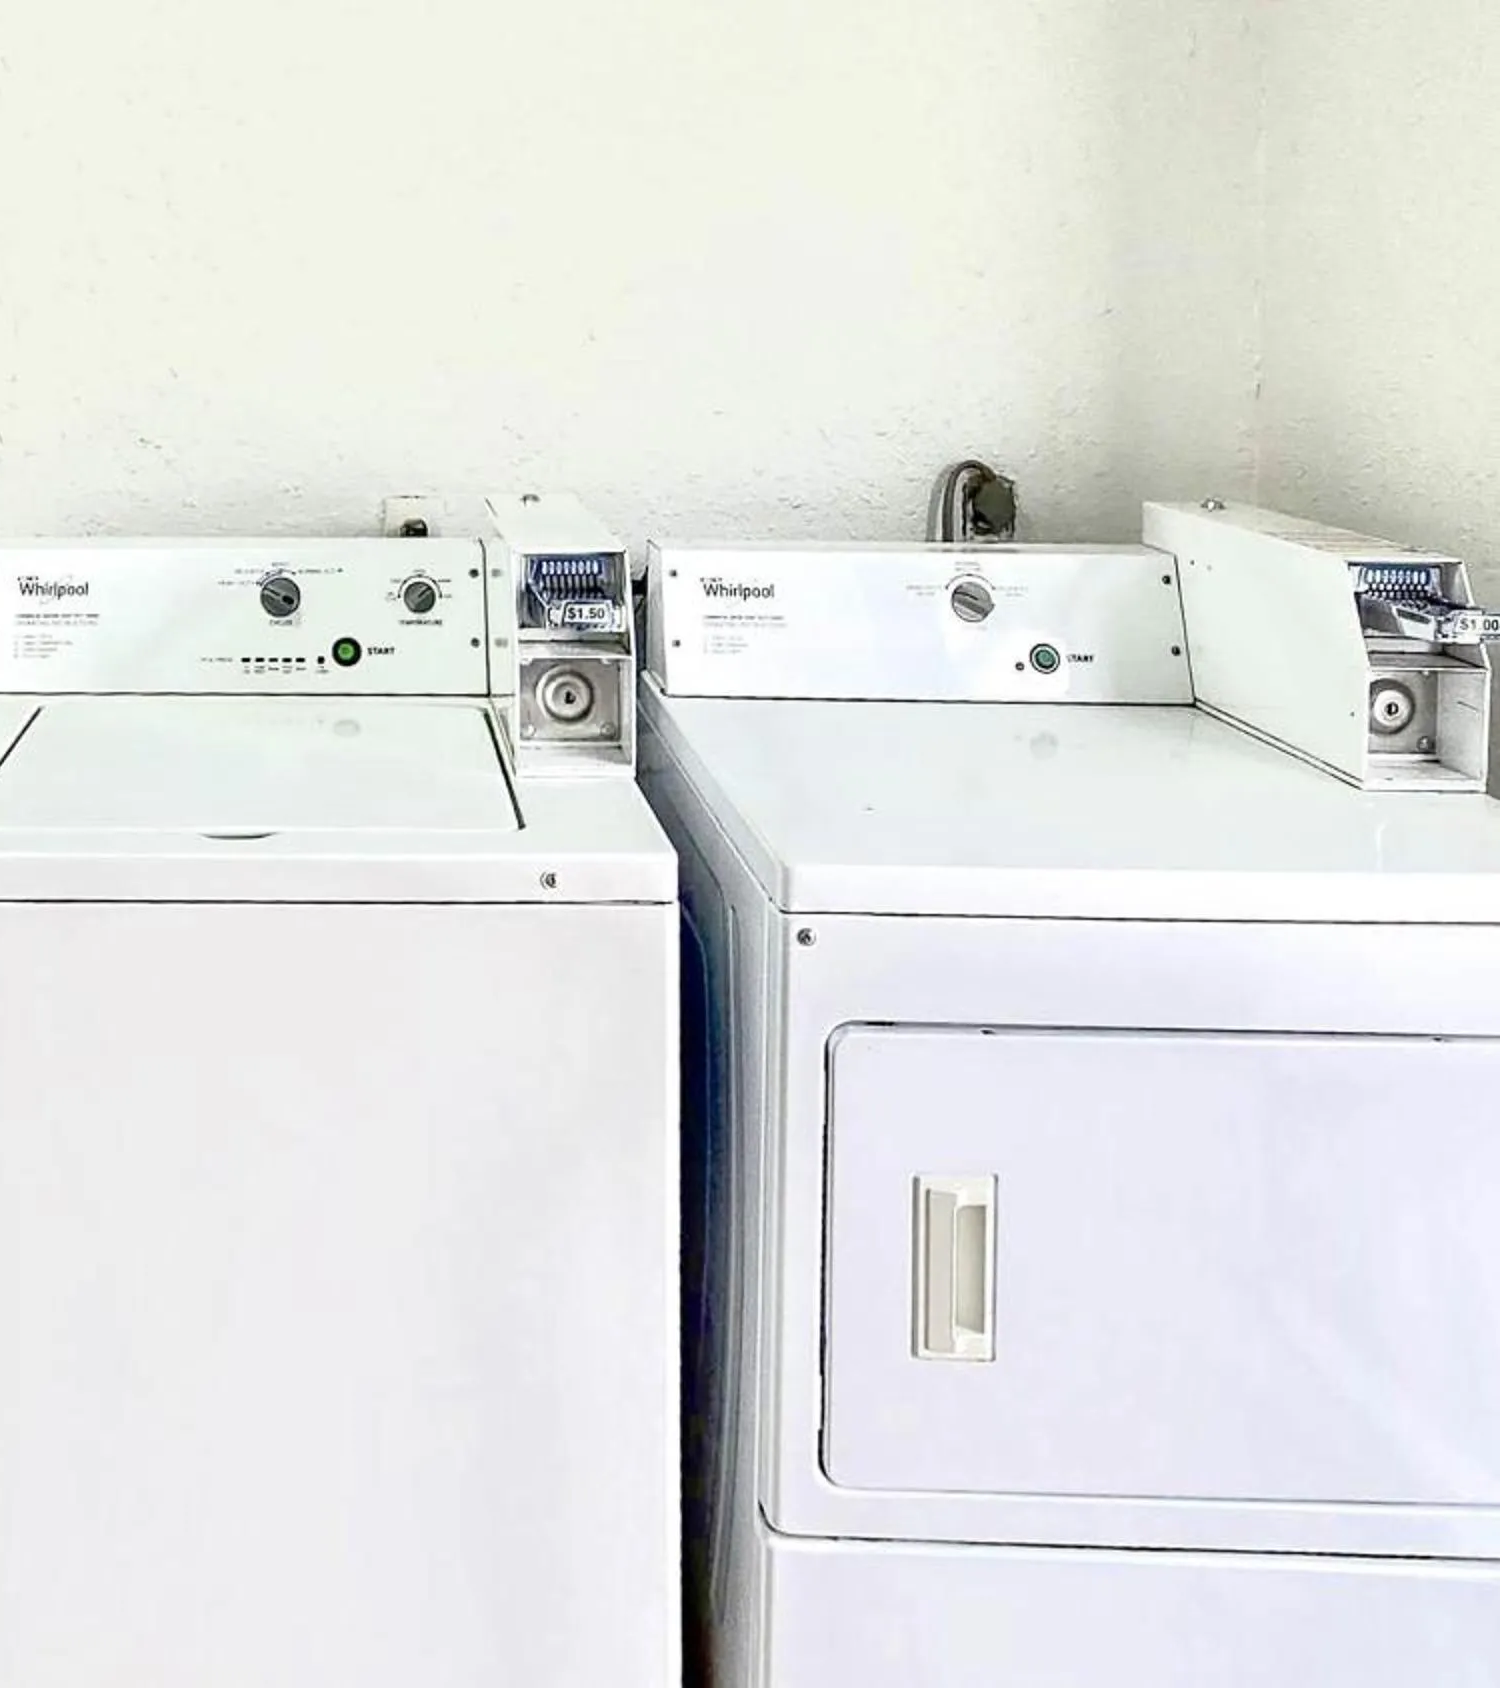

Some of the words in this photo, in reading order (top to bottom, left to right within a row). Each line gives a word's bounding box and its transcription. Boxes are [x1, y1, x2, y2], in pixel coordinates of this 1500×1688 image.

[19, 581, 89, 600] Whirlpool
[703, 583, 775, 602] Whirlpool
[567, 607, 605, 619] $1.50
[367, 647, 395, 656] START
